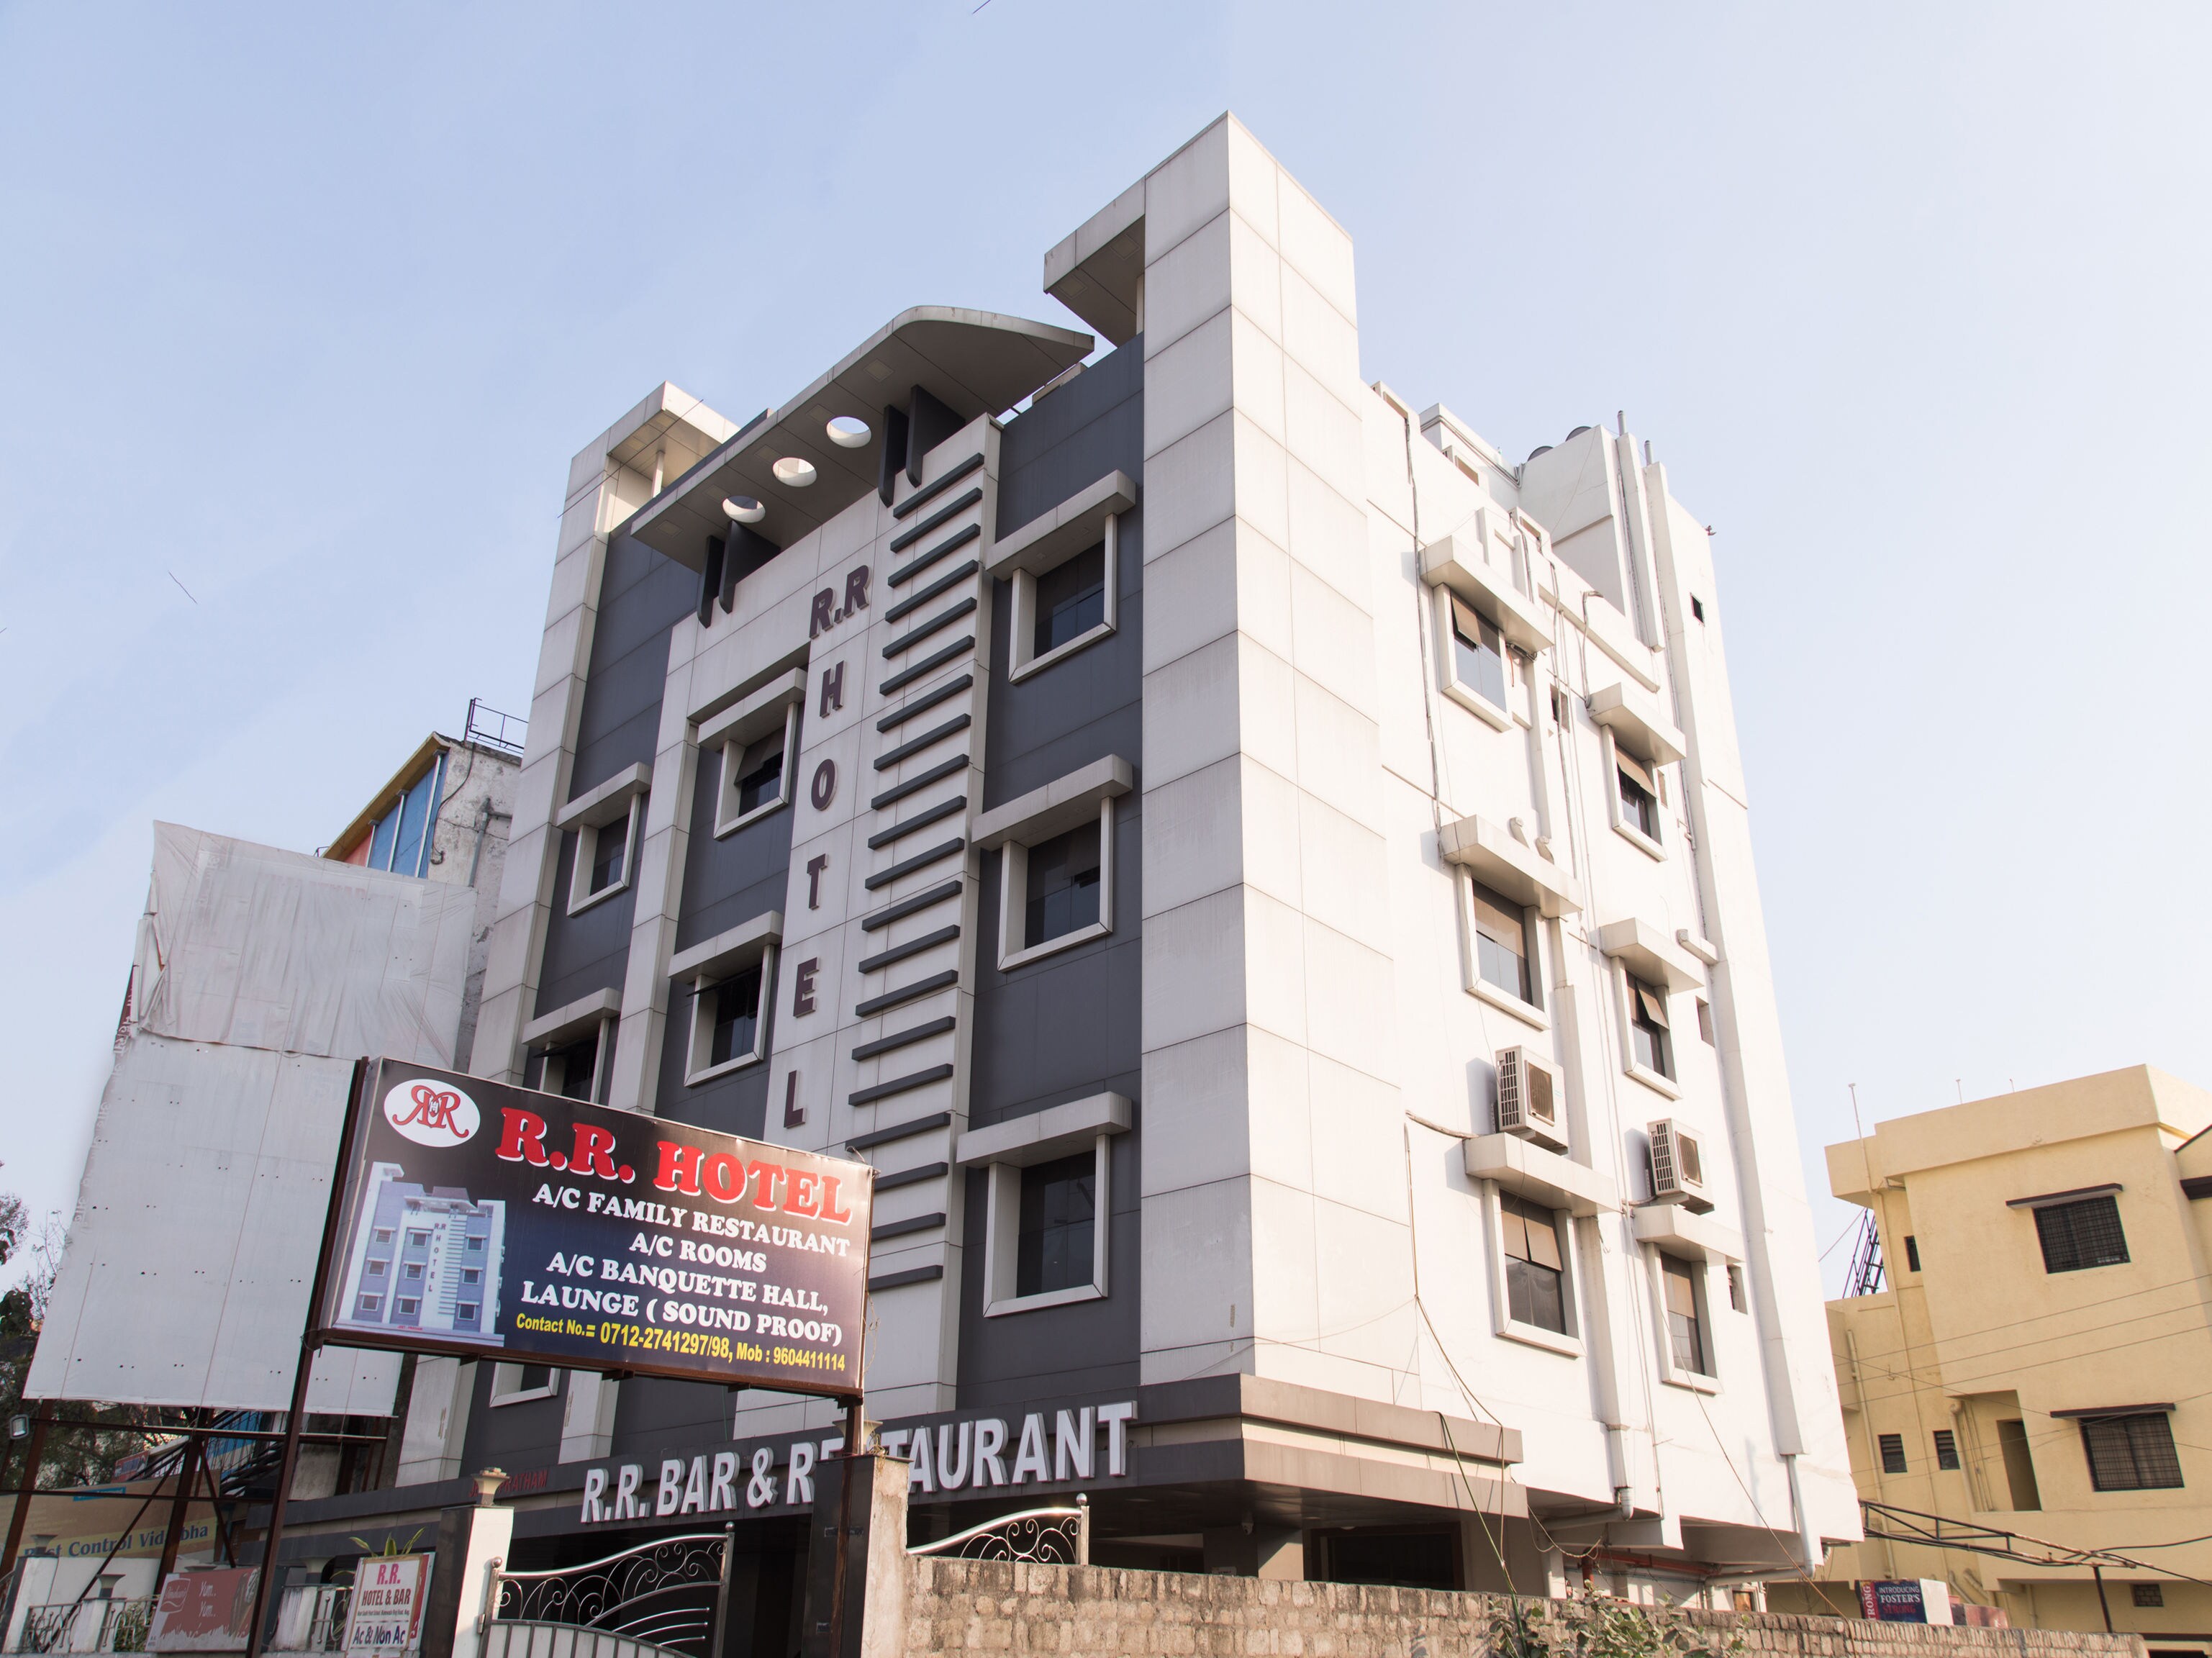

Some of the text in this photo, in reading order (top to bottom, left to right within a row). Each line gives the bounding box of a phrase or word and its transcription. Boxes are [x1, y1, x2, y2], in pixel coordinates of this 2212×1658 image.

[810, 565, 869, 639] R.R
[784, 660, 846, 1129] HOTEL
[495, 1107, 853, 1226] R.R. HOTEL
[532, 1183, 850, 1256] A/C FAMILY RESTAURANT
[628, 1231, 767, 1273] A/C ROOMS
[520, 1280, 639, 1317] LAUNGE
[662, 1300, 751, 1331] SOUND
[756, 1313, 843, 1347] PROOF)
[545, 1251, 828, 1316] A/C BANQUETTE HALL,
[516, 1313, 563, 1333] Contact
[600, 1321, 733, 1364] 0712-2741297/98,
[736, 1341, 762, 1363] Mob
[773, 1346, 846, 1372] 9604411114
[581, 1400, 1138, 1523] R.R. BAR & RTAURANT
[361, 1588, 412, 1606] HOTEL & BAR
[376, 1563, 401, 1585] R.R.
[1880, 1593, 1921, 1603] FOSTER'S
[364, 1626, 373, 1644] &
[373, 1626, 391, 1644] Non
[392, 1625, 406, 1644] Ac
[1882, 1603, 1916, 1614] STRONG
